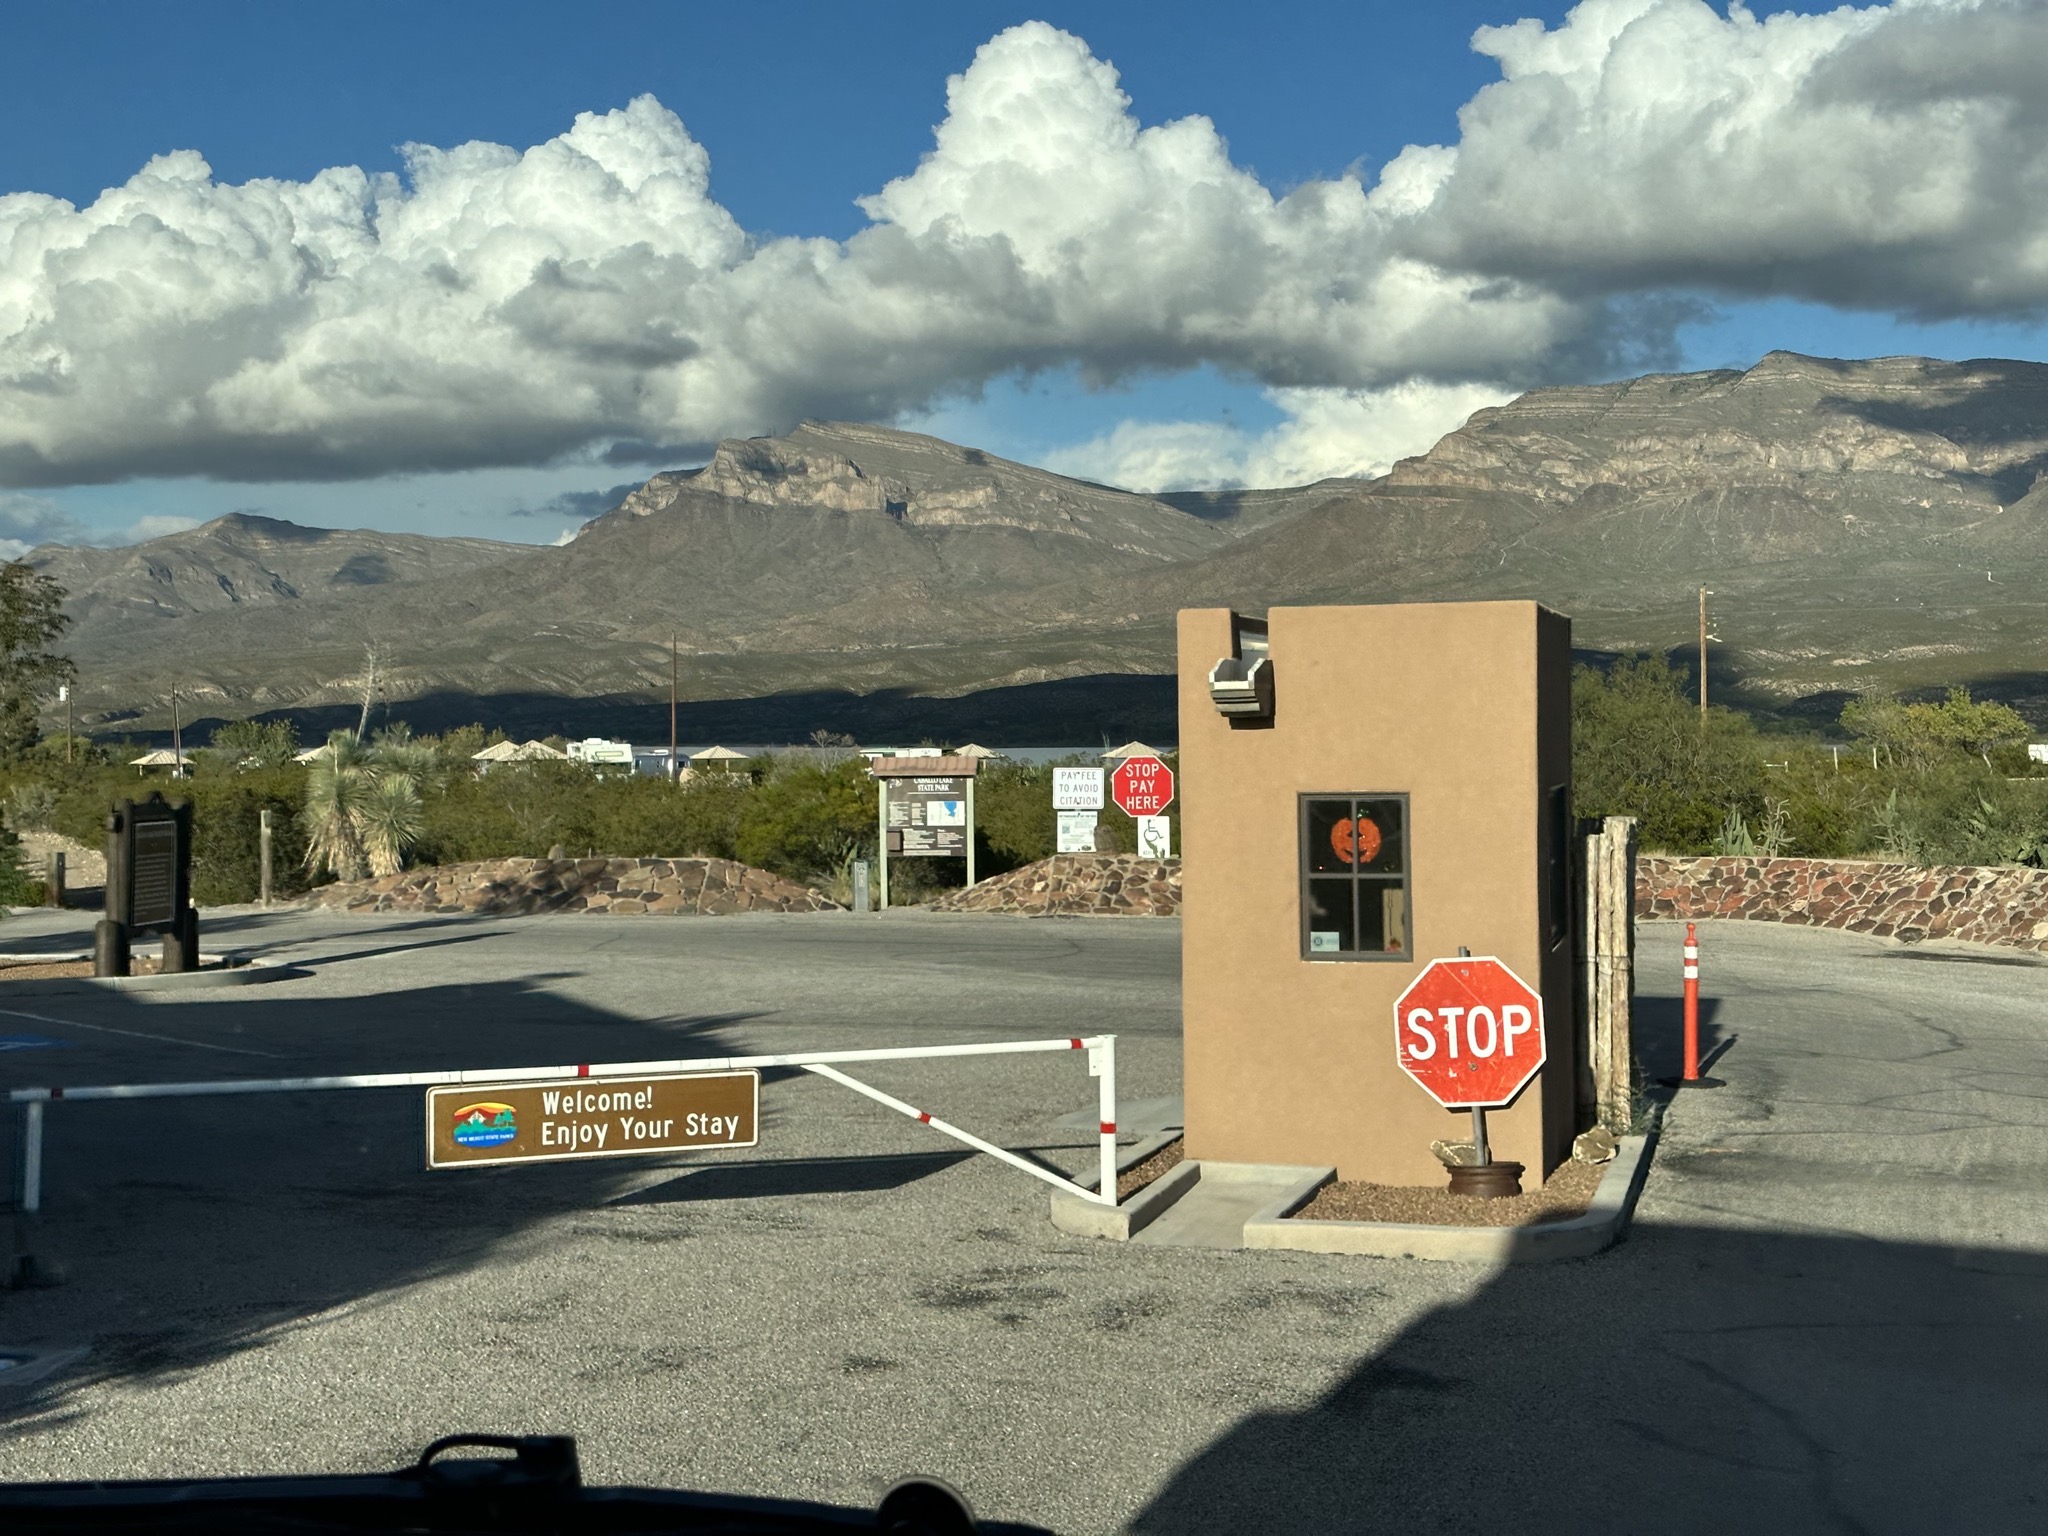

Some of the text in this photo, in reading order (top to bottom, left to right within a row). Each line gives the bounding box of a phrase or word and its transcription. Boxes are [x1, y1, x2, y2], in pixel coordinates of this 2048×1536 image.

[1061, 772, 1096, 780] PAY FEE
[1126, 764, 1159, 777] STOP
[917, 784, 949, 792] STATE PARK
[1059, 784, 1098, 793] TO AVOID
[1130, 780, 1155, 793] PAY
[1060, 797, 1098, 805] CITATION
[1126, 796, 1160, 810] HERE
[1407, 1004, 1532, 1060] STOP
[542, 1085, 653, 1115] Welcome!
[541, 1112, 739, 1151] Enjoy Your Stay
